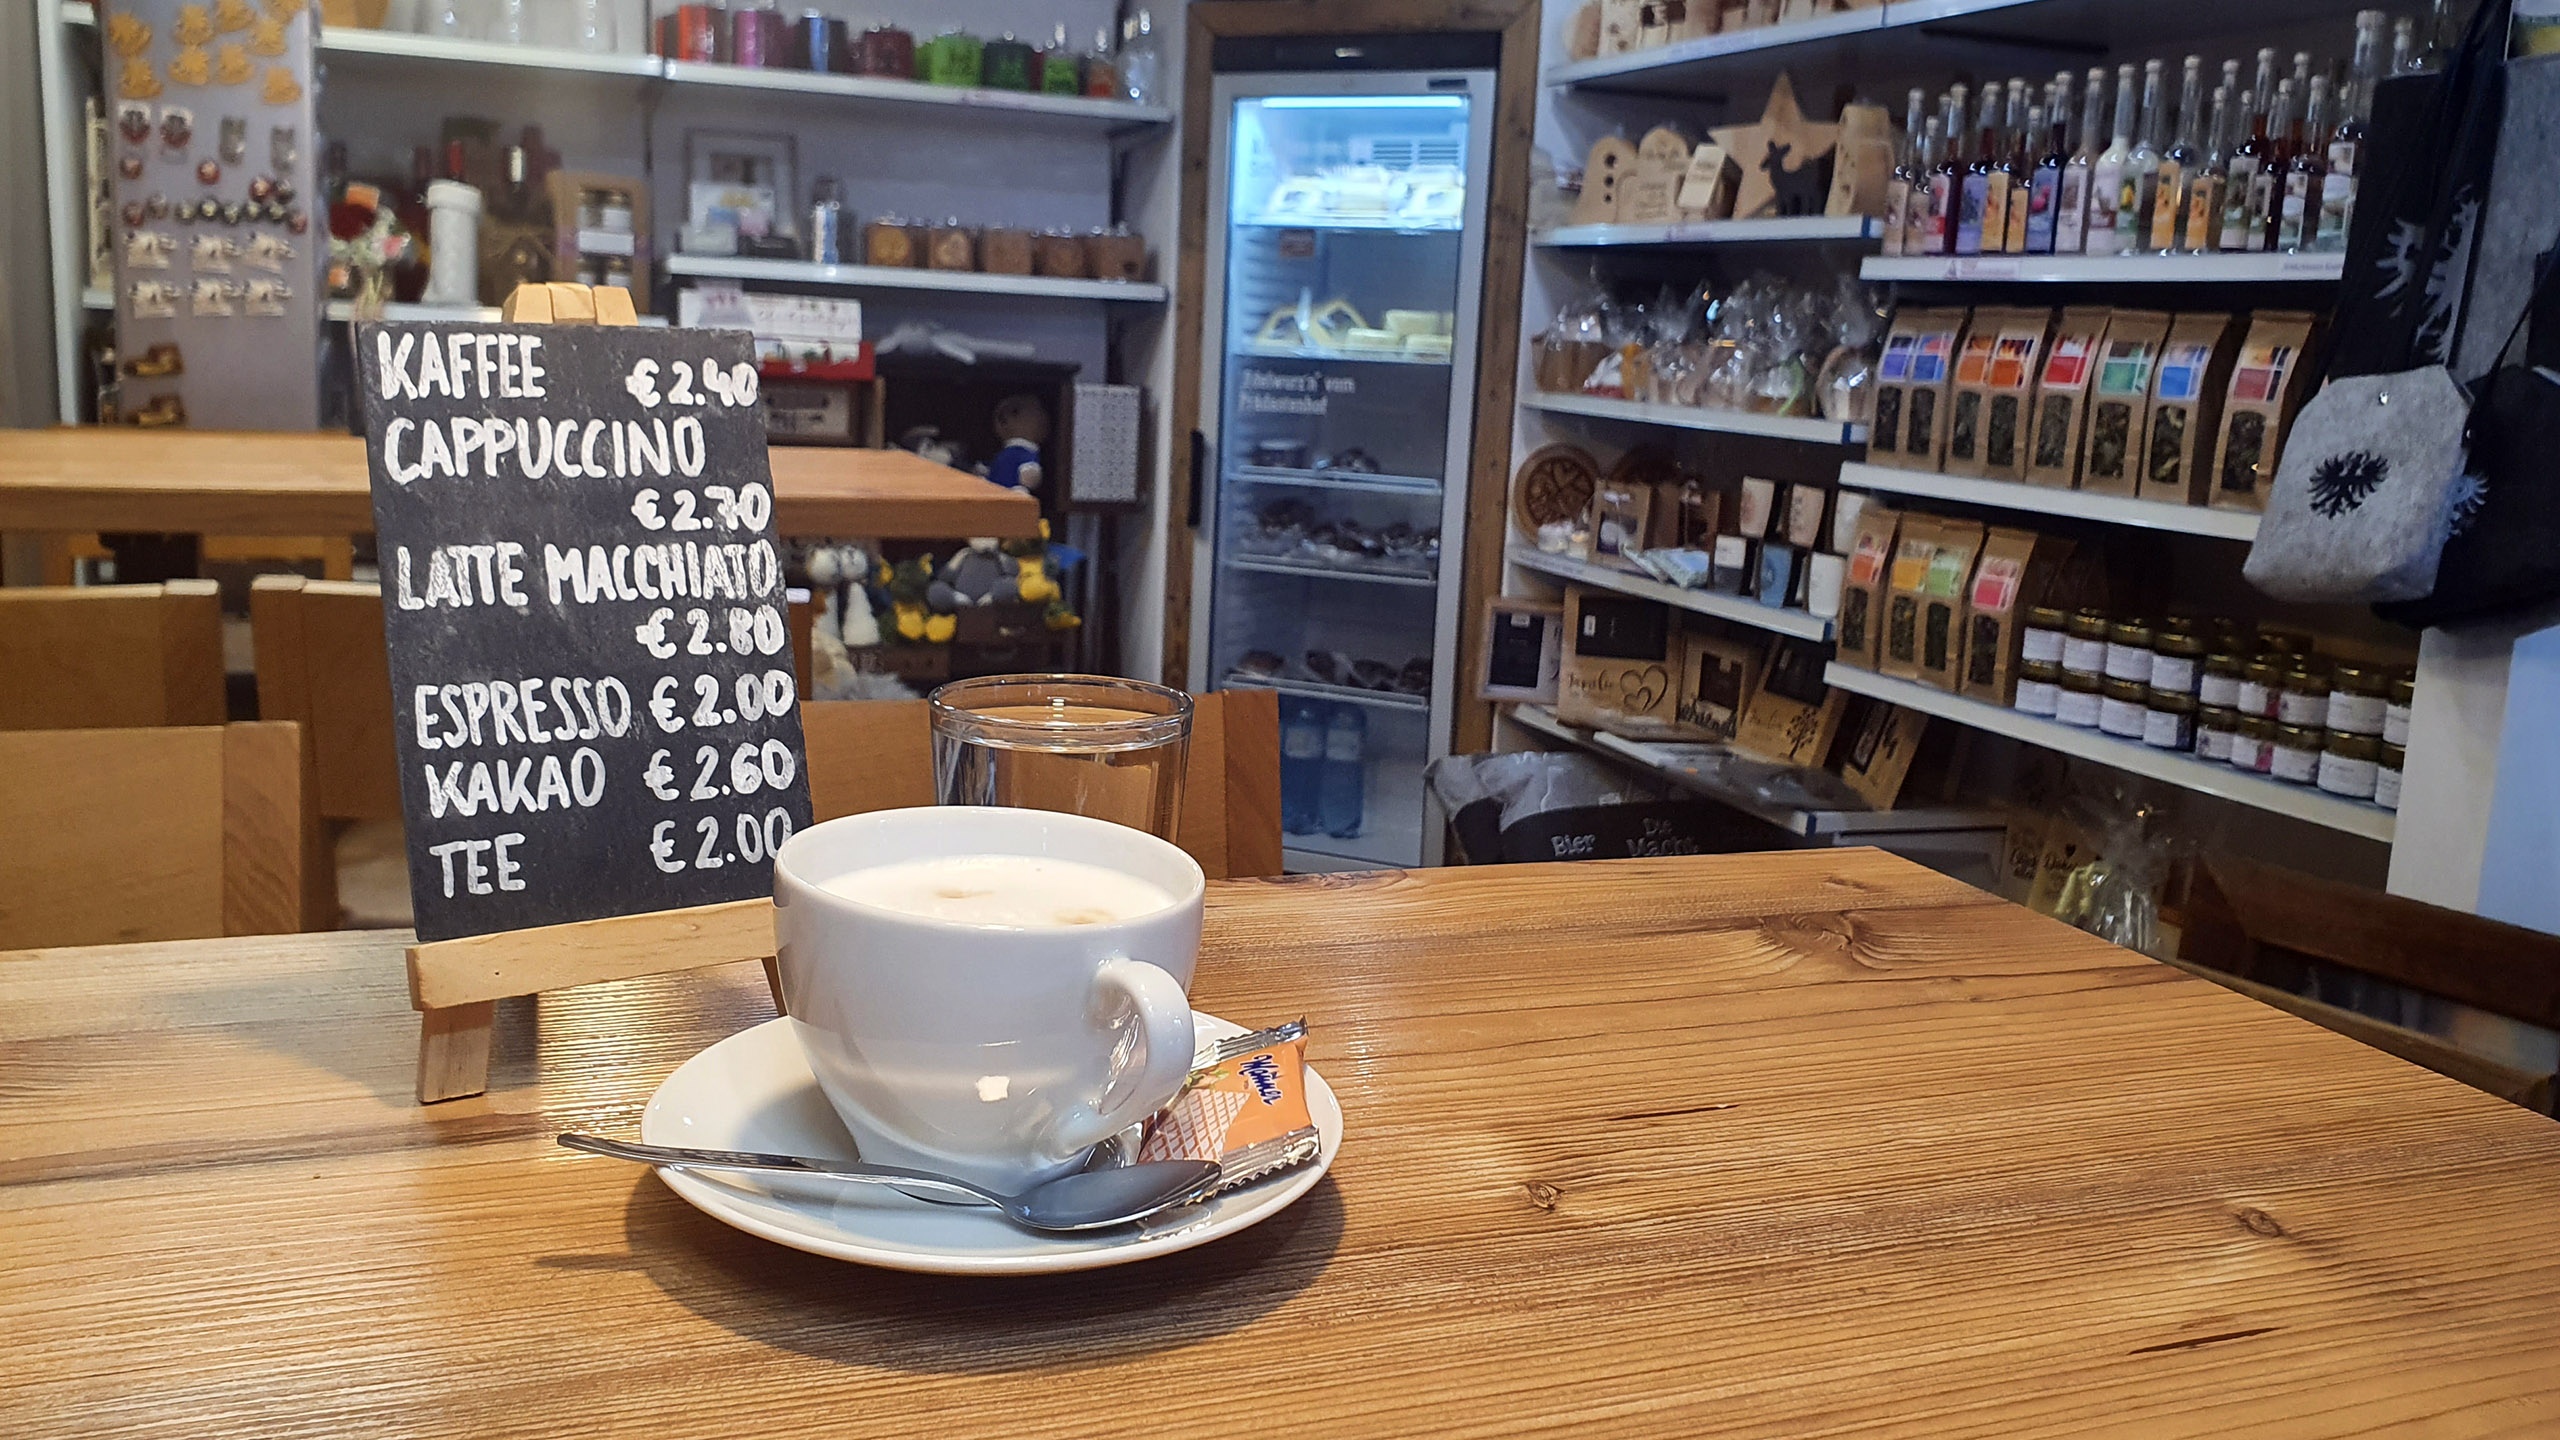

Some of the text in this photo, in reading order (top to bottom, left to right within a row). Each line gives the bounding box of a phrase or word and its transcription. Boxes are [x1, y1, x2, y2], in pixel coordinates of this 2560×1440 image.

[376, 330, 547, 401] KAFFEE
[383, 412, 706, 486] CAPPUCCINO
[396, 538, 778, 611] LATTE MACCHIATO
[414, 675, 633, 750] ESPRESSO
[424, 746, 606, 819] KAKAO
[429, 832, 526, 899] TEE
[1551, 833, 1596, 857] Bier
